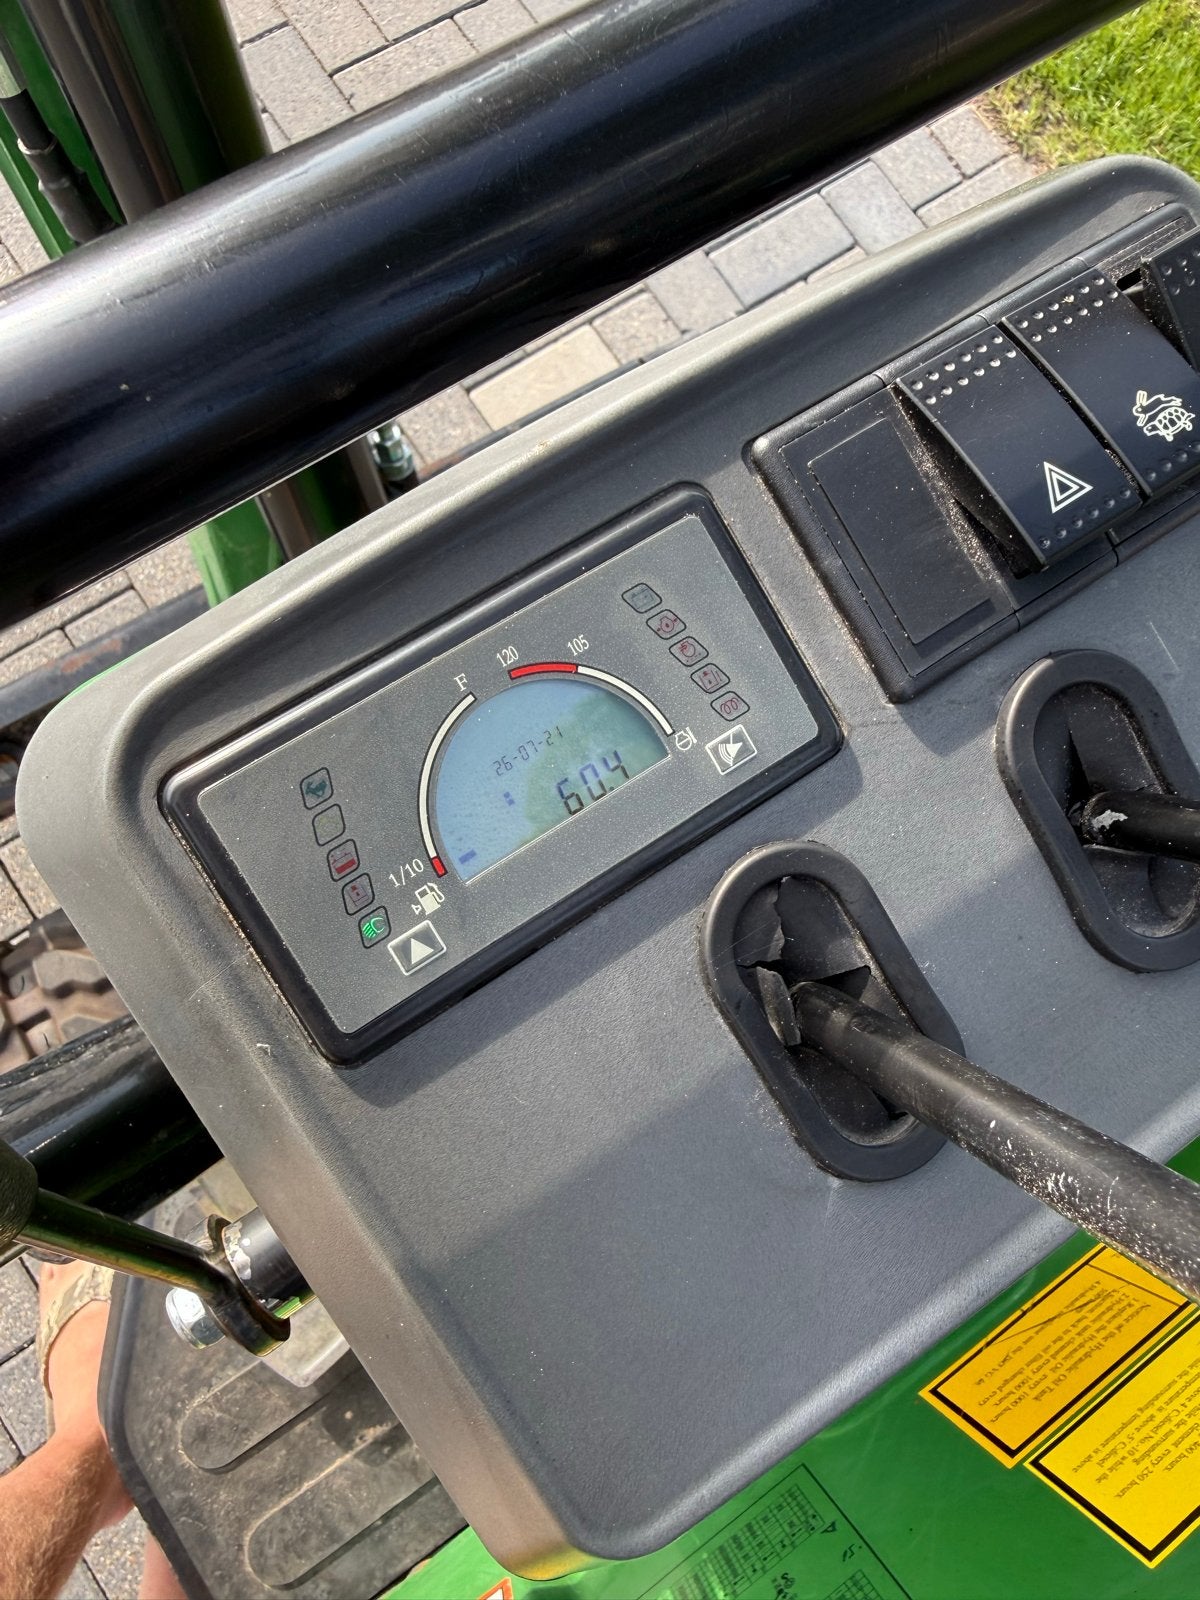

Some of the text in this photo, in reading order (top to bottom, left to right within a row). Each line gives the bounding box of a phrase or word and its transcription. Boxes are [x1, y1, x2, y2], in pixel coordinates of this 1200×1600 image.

[567, 634, 590, 656] 105
[496, 645, 519, 667] 120
[453, 673, 468, 692] F
[493, 725, 563, 777] 26-07-21
[556, 750, 630, 816] 60.4
[389, 858, 424, 888] 1/10
[1094, 1323, 1108, 1335] the
[1101, 1330, 1117, 1343] the
[1114, 1323, 1126, 1333] of
[1060, 1332, 1097, 1362] Hydraulic
[1030, 1357, 1051, 1375] every
[1064, 1340, 1105, 1374] Hydraulic
[1049, 1361, 1063, 1373] Oil
[1026, 1372, 1048, 1390] every
[1051, 1373, 1067, 1386] Oil
[976, 1389, 998, 1407] every
[1009, 1390, 1029, 1407] 1000
[1032, 1385, 1053, 1403] Tank
[1133, 1412, 1157, 1435] above
[1173, 1416, 1188, 1432] the
[1070, 1452, 1095, 1474] above
[1149, 1445, 1171, 1468] every
[1094, 1470, 1111, 1486] the
[1135, 1465, 1153, 1482] 250
